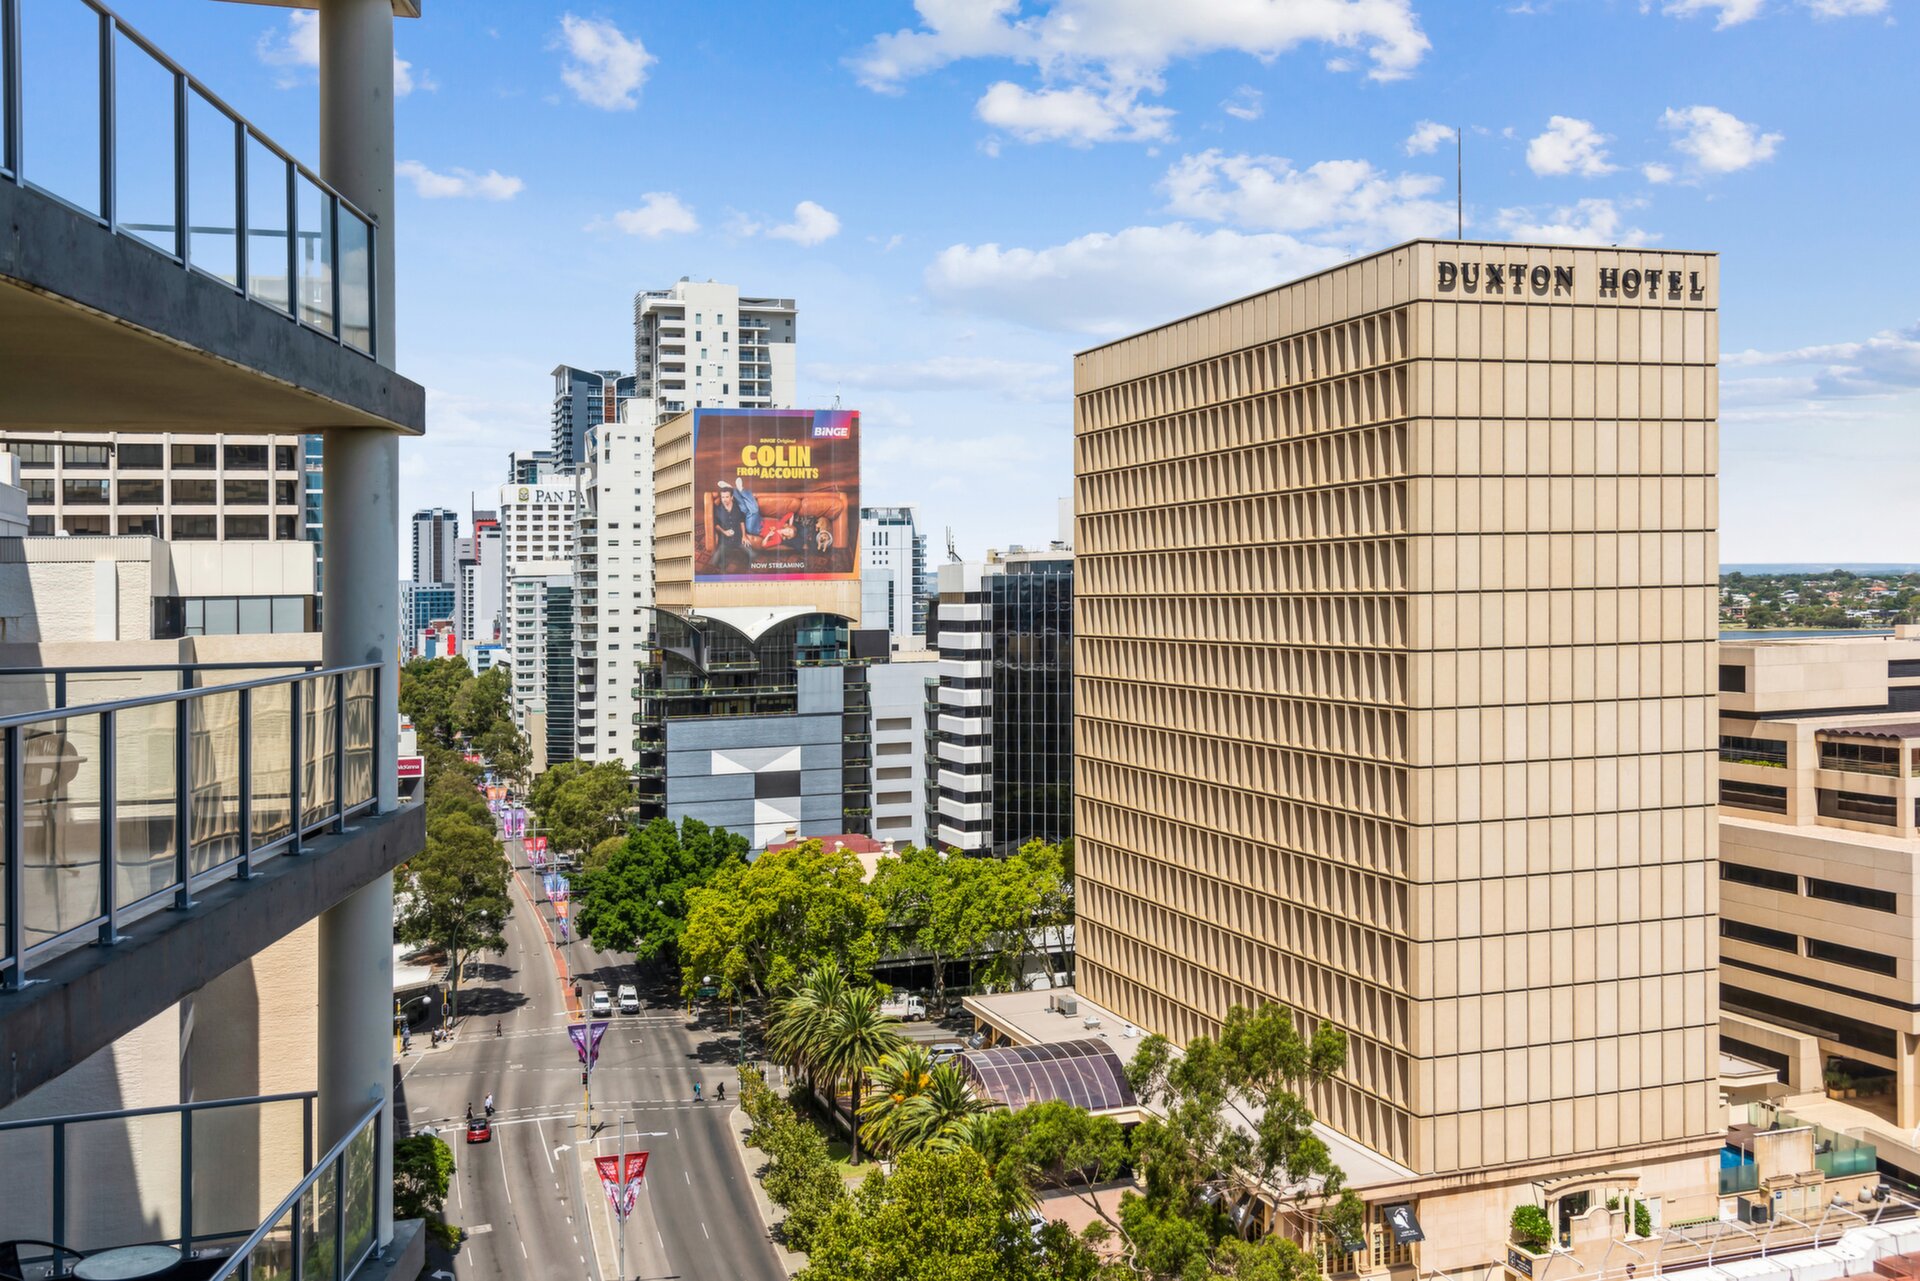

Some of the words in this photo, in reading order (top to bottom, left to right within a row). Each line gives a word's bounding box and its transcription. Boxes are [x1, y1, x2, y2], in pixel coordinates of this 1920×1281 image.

[1438, 261, 1574, 289] DUXTON
[1601, 268, 1704, 292] HOTEL
[742, 445, 811, 467] COLIN
[737, 467, 760, 476] FROM
[760, 467, 819, 479] ACCOUNTS
[536, 490, 563, 502] PAN
